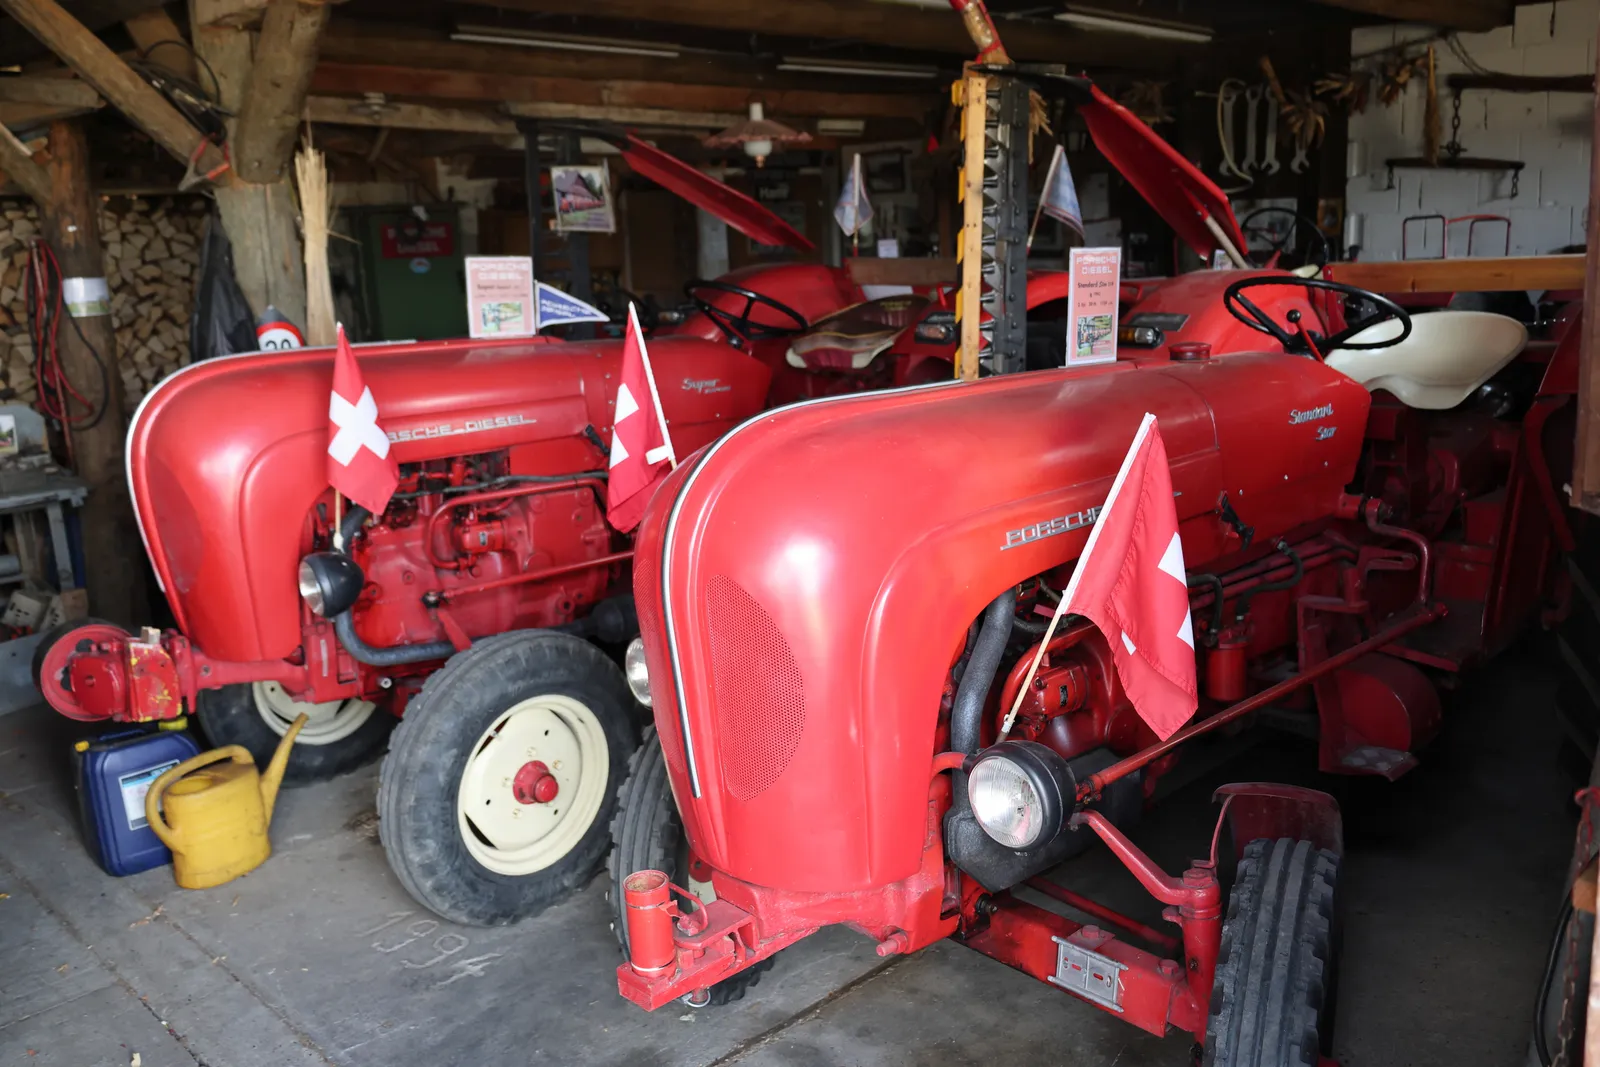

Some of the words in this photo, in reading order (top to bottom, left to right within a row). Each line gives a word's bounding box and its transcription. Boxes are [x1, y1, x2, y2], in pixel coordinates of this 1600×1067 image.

[1076, 255, 1117, 265] PORSCHE
[1081, 266, 1113, 275] DIESEL
[1288, 402, 1334, 425] Standard
[465, 414, 536, 433] DIESEL
[1315, 426, 1337, 441] Star
